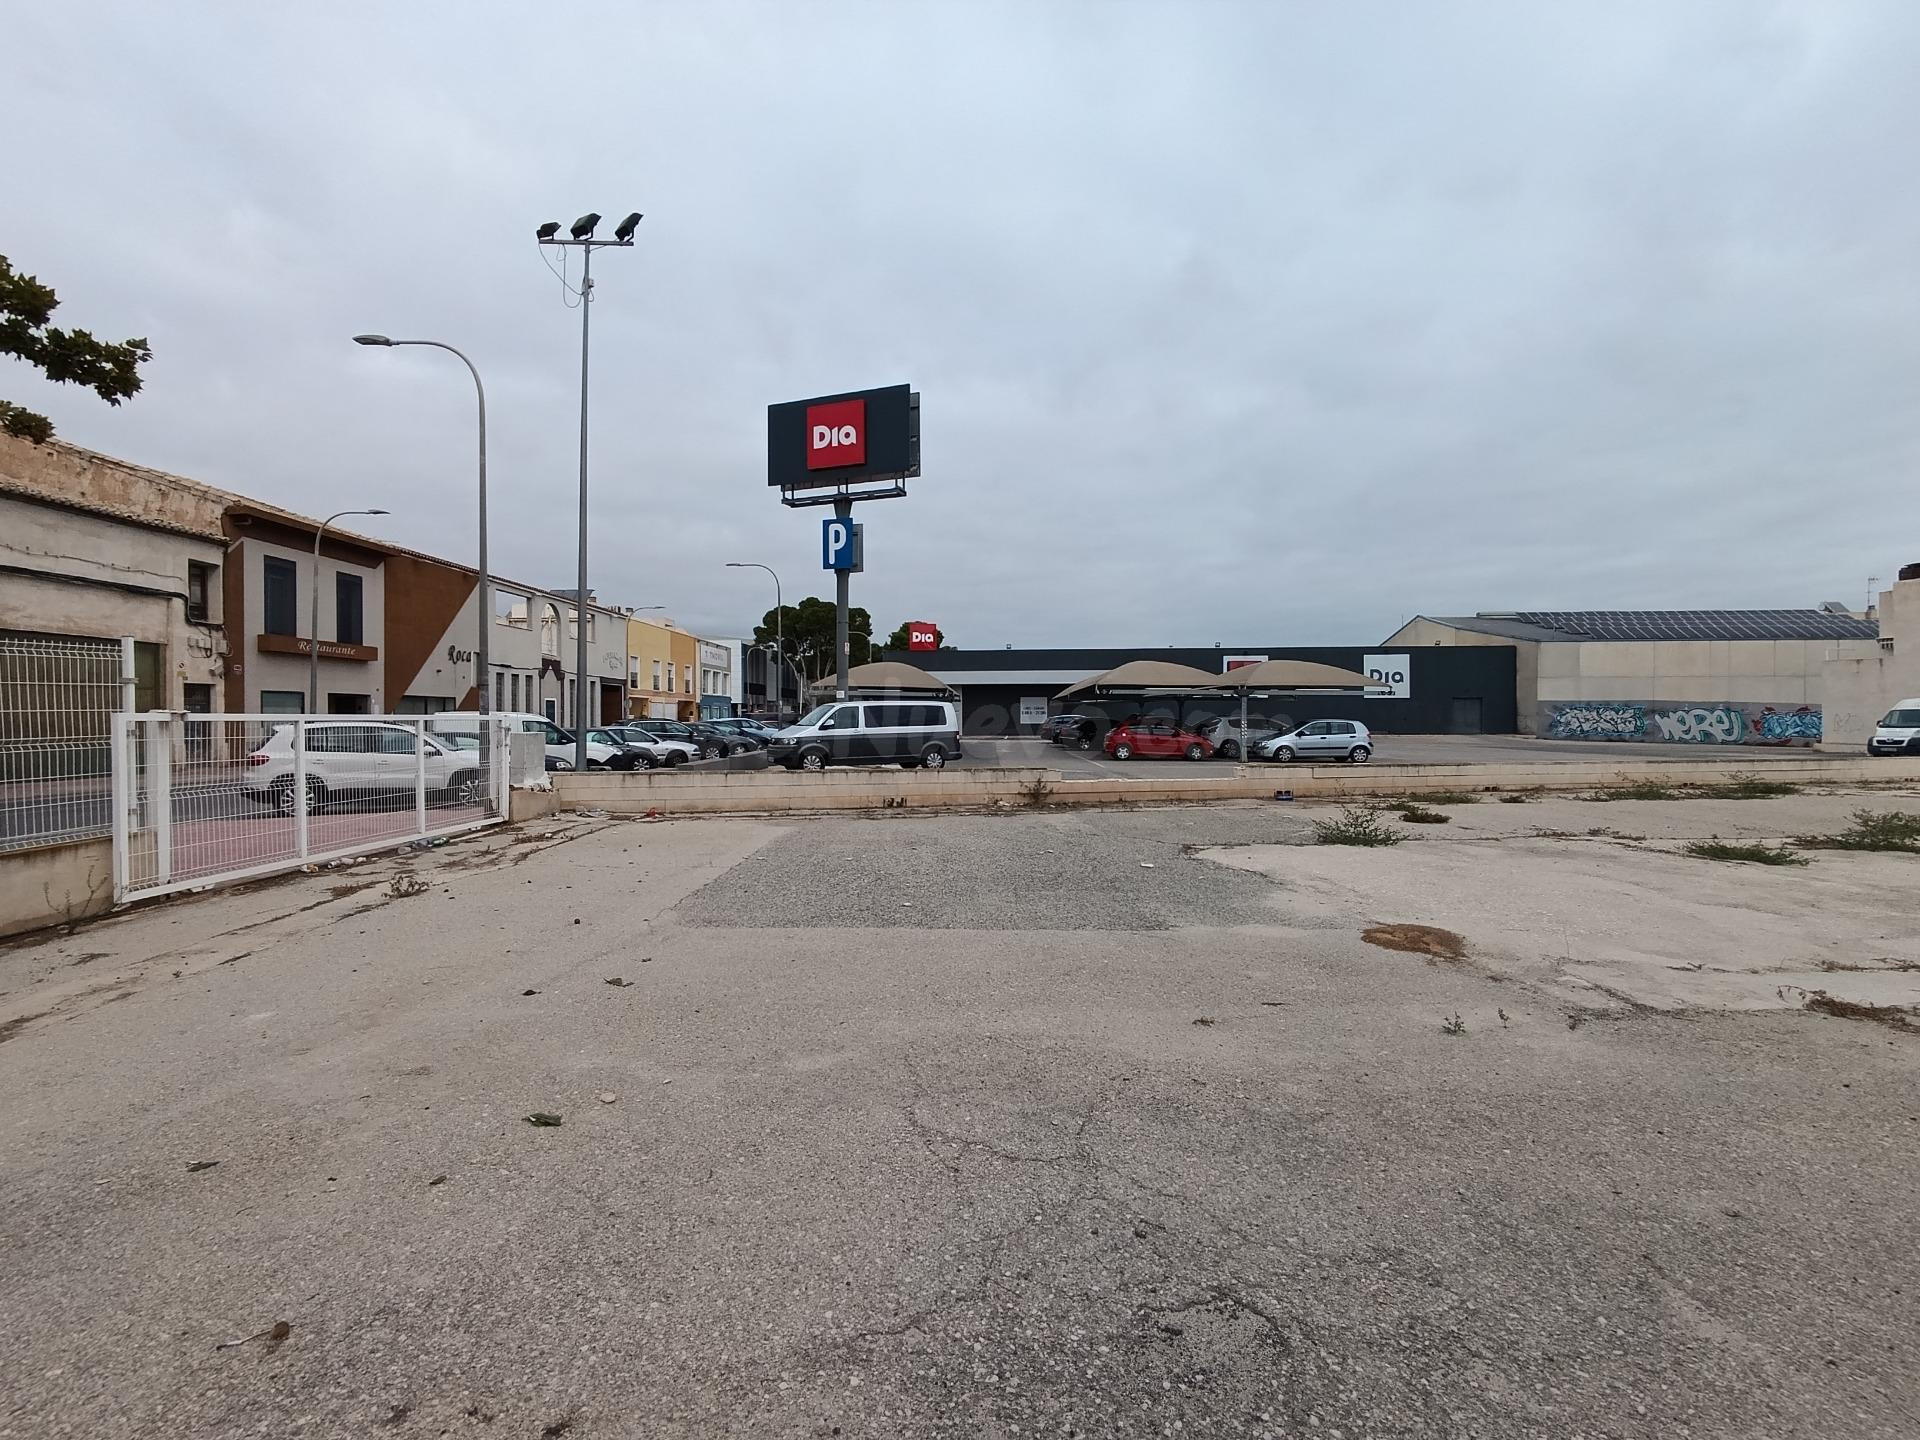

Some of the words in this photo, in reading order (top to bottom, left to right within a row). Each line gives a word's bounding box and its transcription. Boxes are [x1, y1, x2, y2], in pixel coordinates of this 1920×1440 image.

[828, 522, 847, 565] P
[297, 640, 356, 655] Retaurante
[448, 644, 472, 665] Roca
